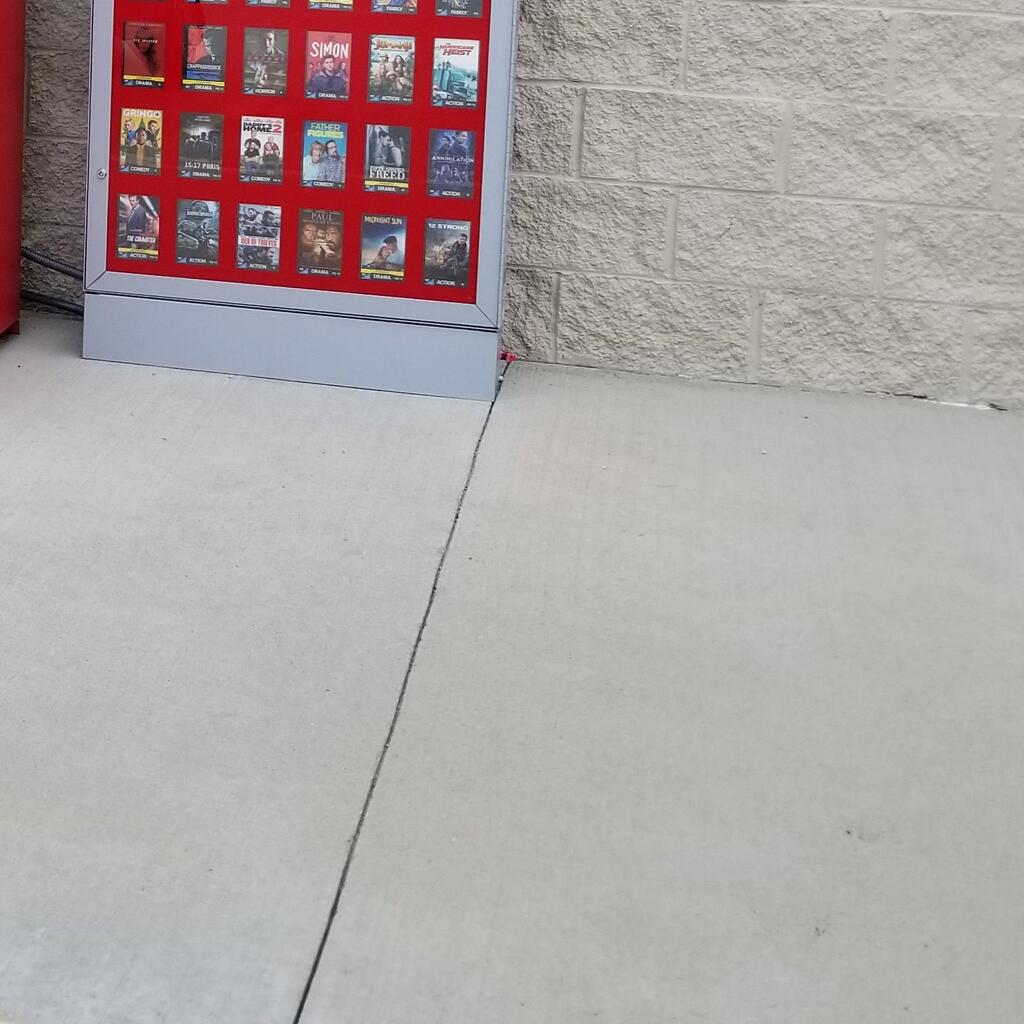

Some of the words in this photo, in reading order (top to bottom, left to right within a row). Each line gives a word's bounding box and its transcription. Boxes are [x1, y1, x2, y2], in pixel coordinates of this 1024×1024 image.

[310, 41, 349, 59] SIMON
[123, 109, 161, 118] GRINGO
[272, 124, 282, 134] 2
[311, 123, 341, 131] FATHER
[307, 130, 344, 139] FIGURES
[432, 155, 474, 163] ANNIHILATION
[369, 169, 405, 180] FREED
[310, 212, 333, 221] PAUL
[364, 216, 391, 224] MIDNIGHT
